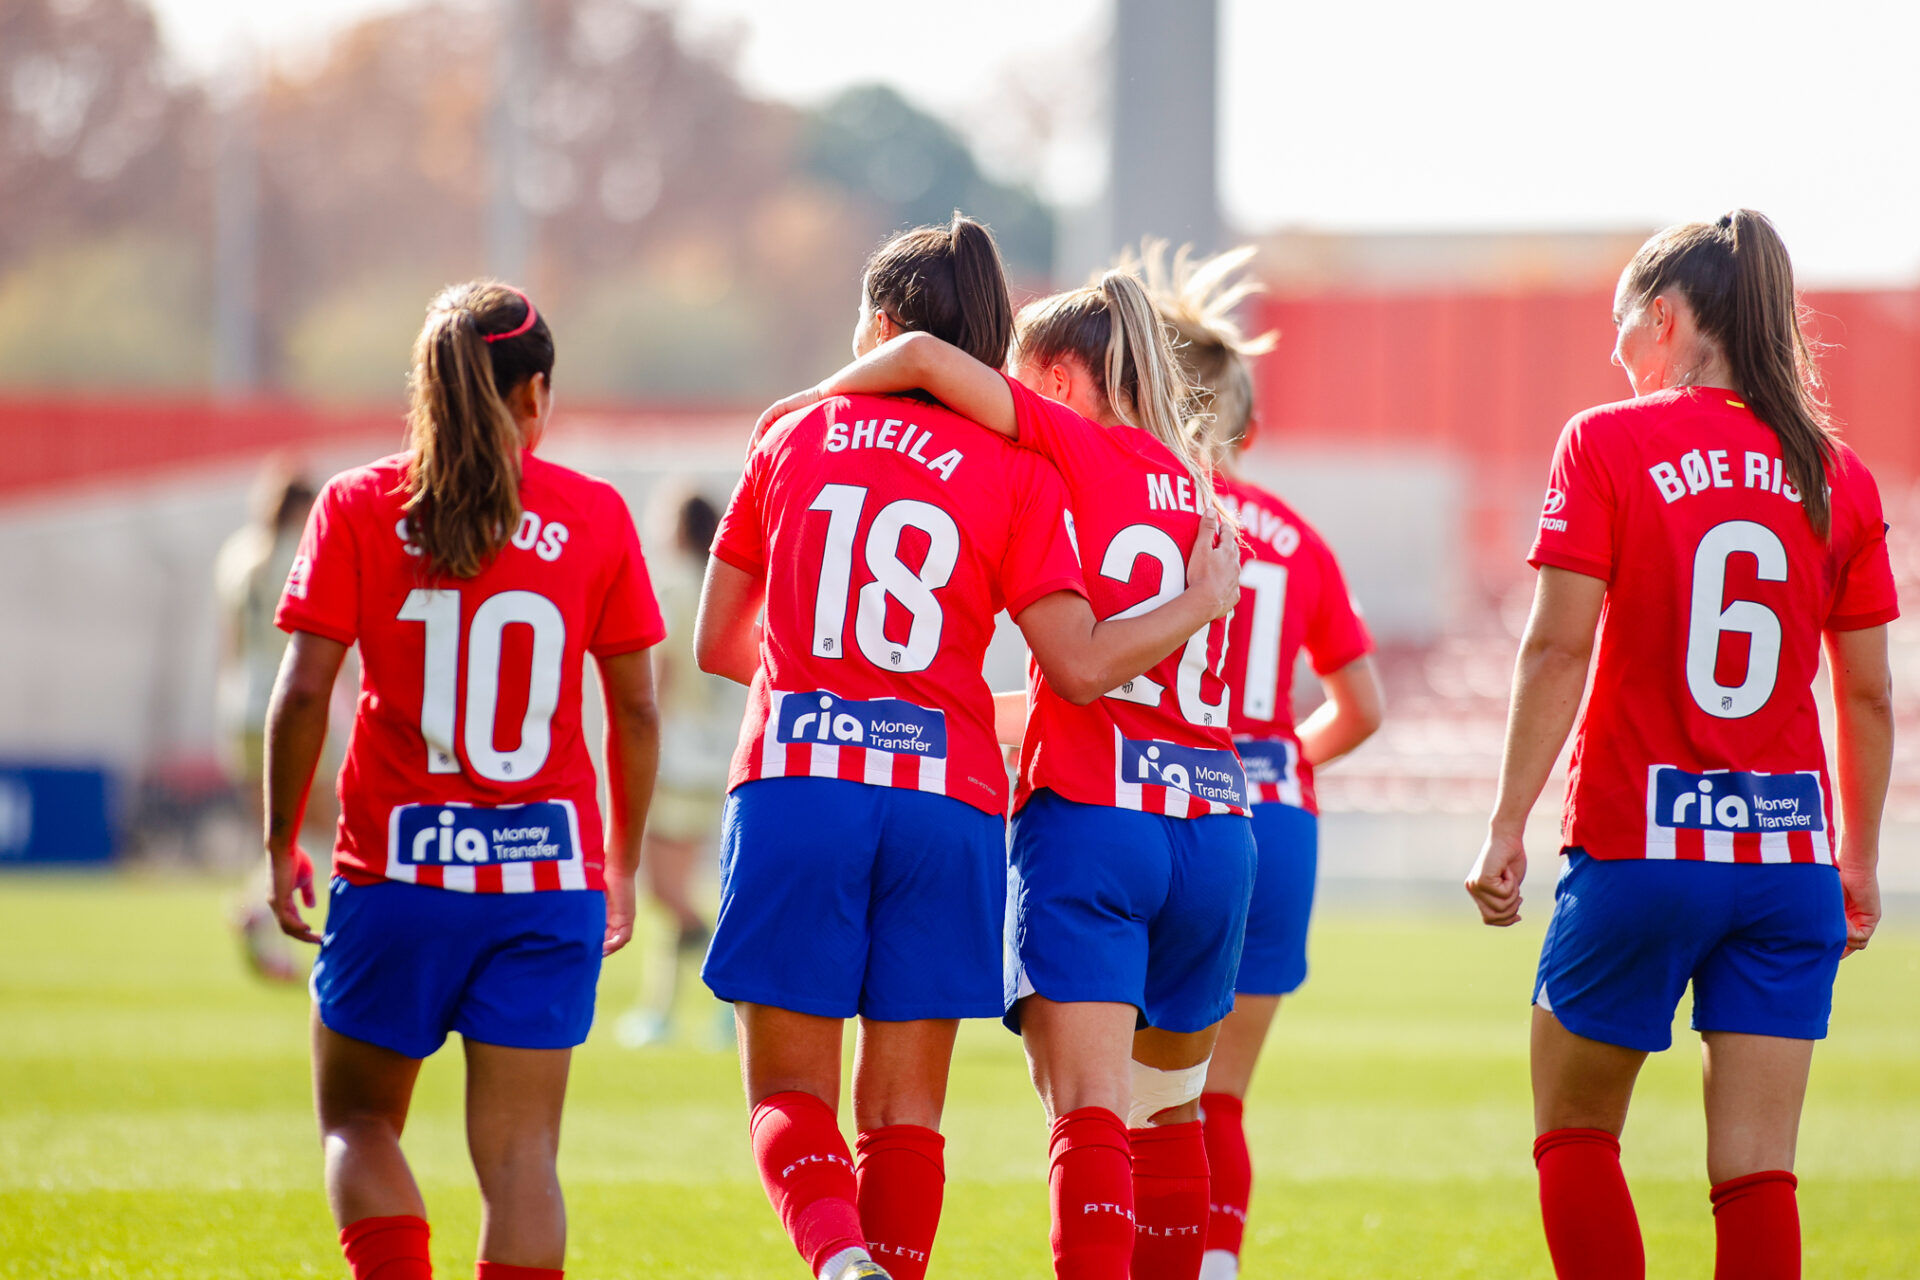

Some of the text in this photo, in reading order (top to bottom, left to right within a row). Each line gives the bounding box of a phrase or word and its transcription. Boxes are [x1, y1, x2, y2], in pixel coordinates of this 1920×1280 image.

[827, 416, 964, 482] SHEILA
[1648, 448, 1734, 505] BØE
[808, 483, 960, 673] 18
[1099, 522, 1235, 729] 20
[1686, 520, 1788, 719] 6
[396, 588, 567, 783] 10
[791, 695, 864, 743] ria
[870, 719, 924, 739] Money
[869, 734, 932, 754] Transfer
[1194, 766, 1234, 787] Money
[1194, 783, 1241, 803] Transfer
[1672, 779, 1750, 829] ria
[1753, 794, 1800, 813] Money
[1754, 811, 1812, 829] Transfer
[411, 809, 490, 863] ria
[492, 826, 551, 844] Money
[492, 842, 561, 860] Transfer
[1135, 1224, 1199, 1238] TLETI
[865, 1241, 925, 1263] TLETI
